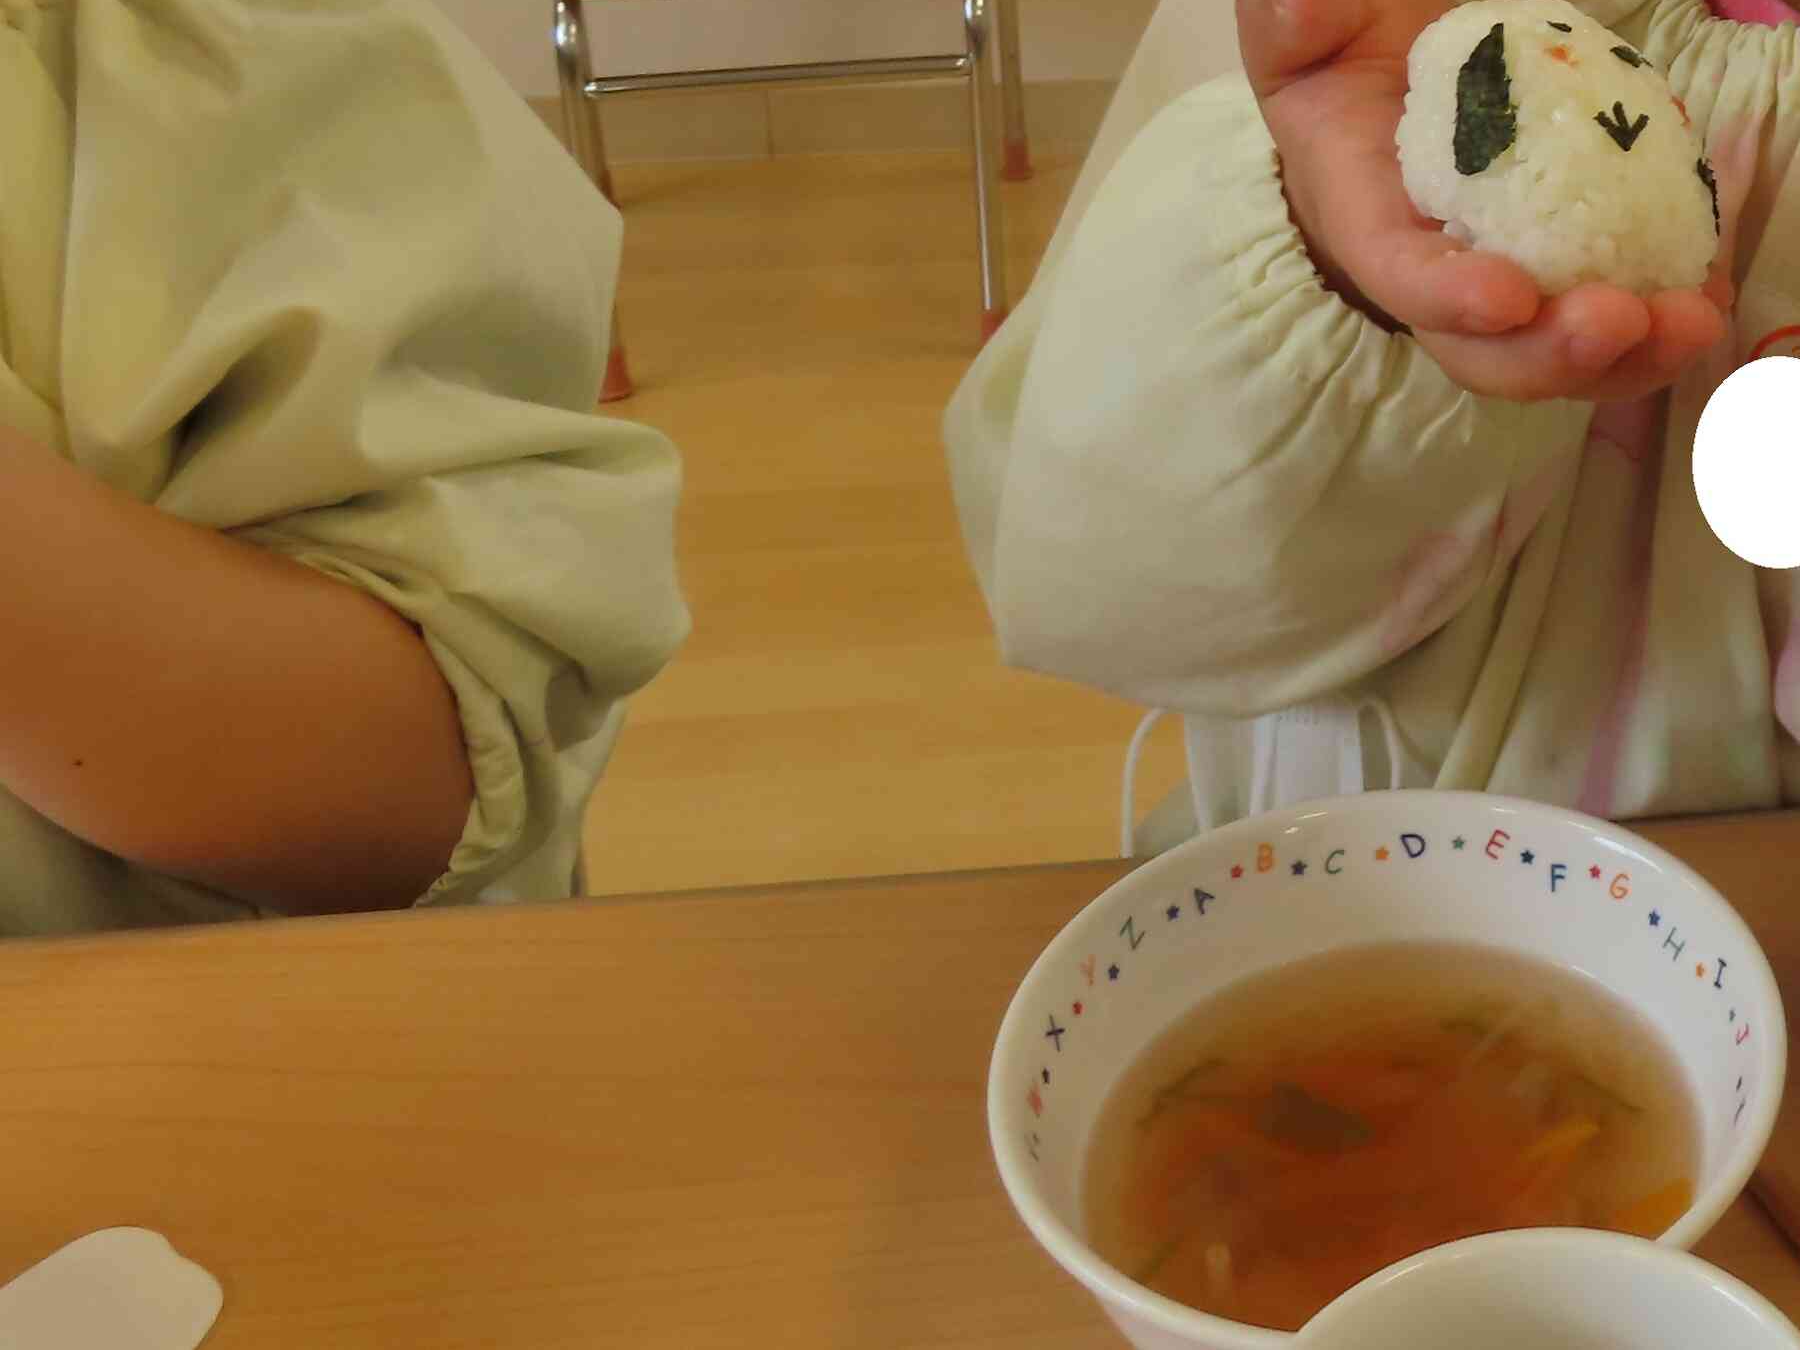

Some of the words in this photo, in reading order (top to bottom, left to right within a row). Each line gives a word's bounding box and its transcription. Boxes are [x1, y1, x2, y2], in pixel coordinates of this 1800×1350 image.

[1193, 887, 1216, 915] A
[1256, 841, 1275, 874] B
[1324, 849, 1345, 876] C
[1400, 833, 1426, 858] D
[1484, 829, 1511, 860] E
[1550, 863, 1567, 893] F
[1609, 873, 1630, 900] G
[1662, 926, 1686, 962] H
